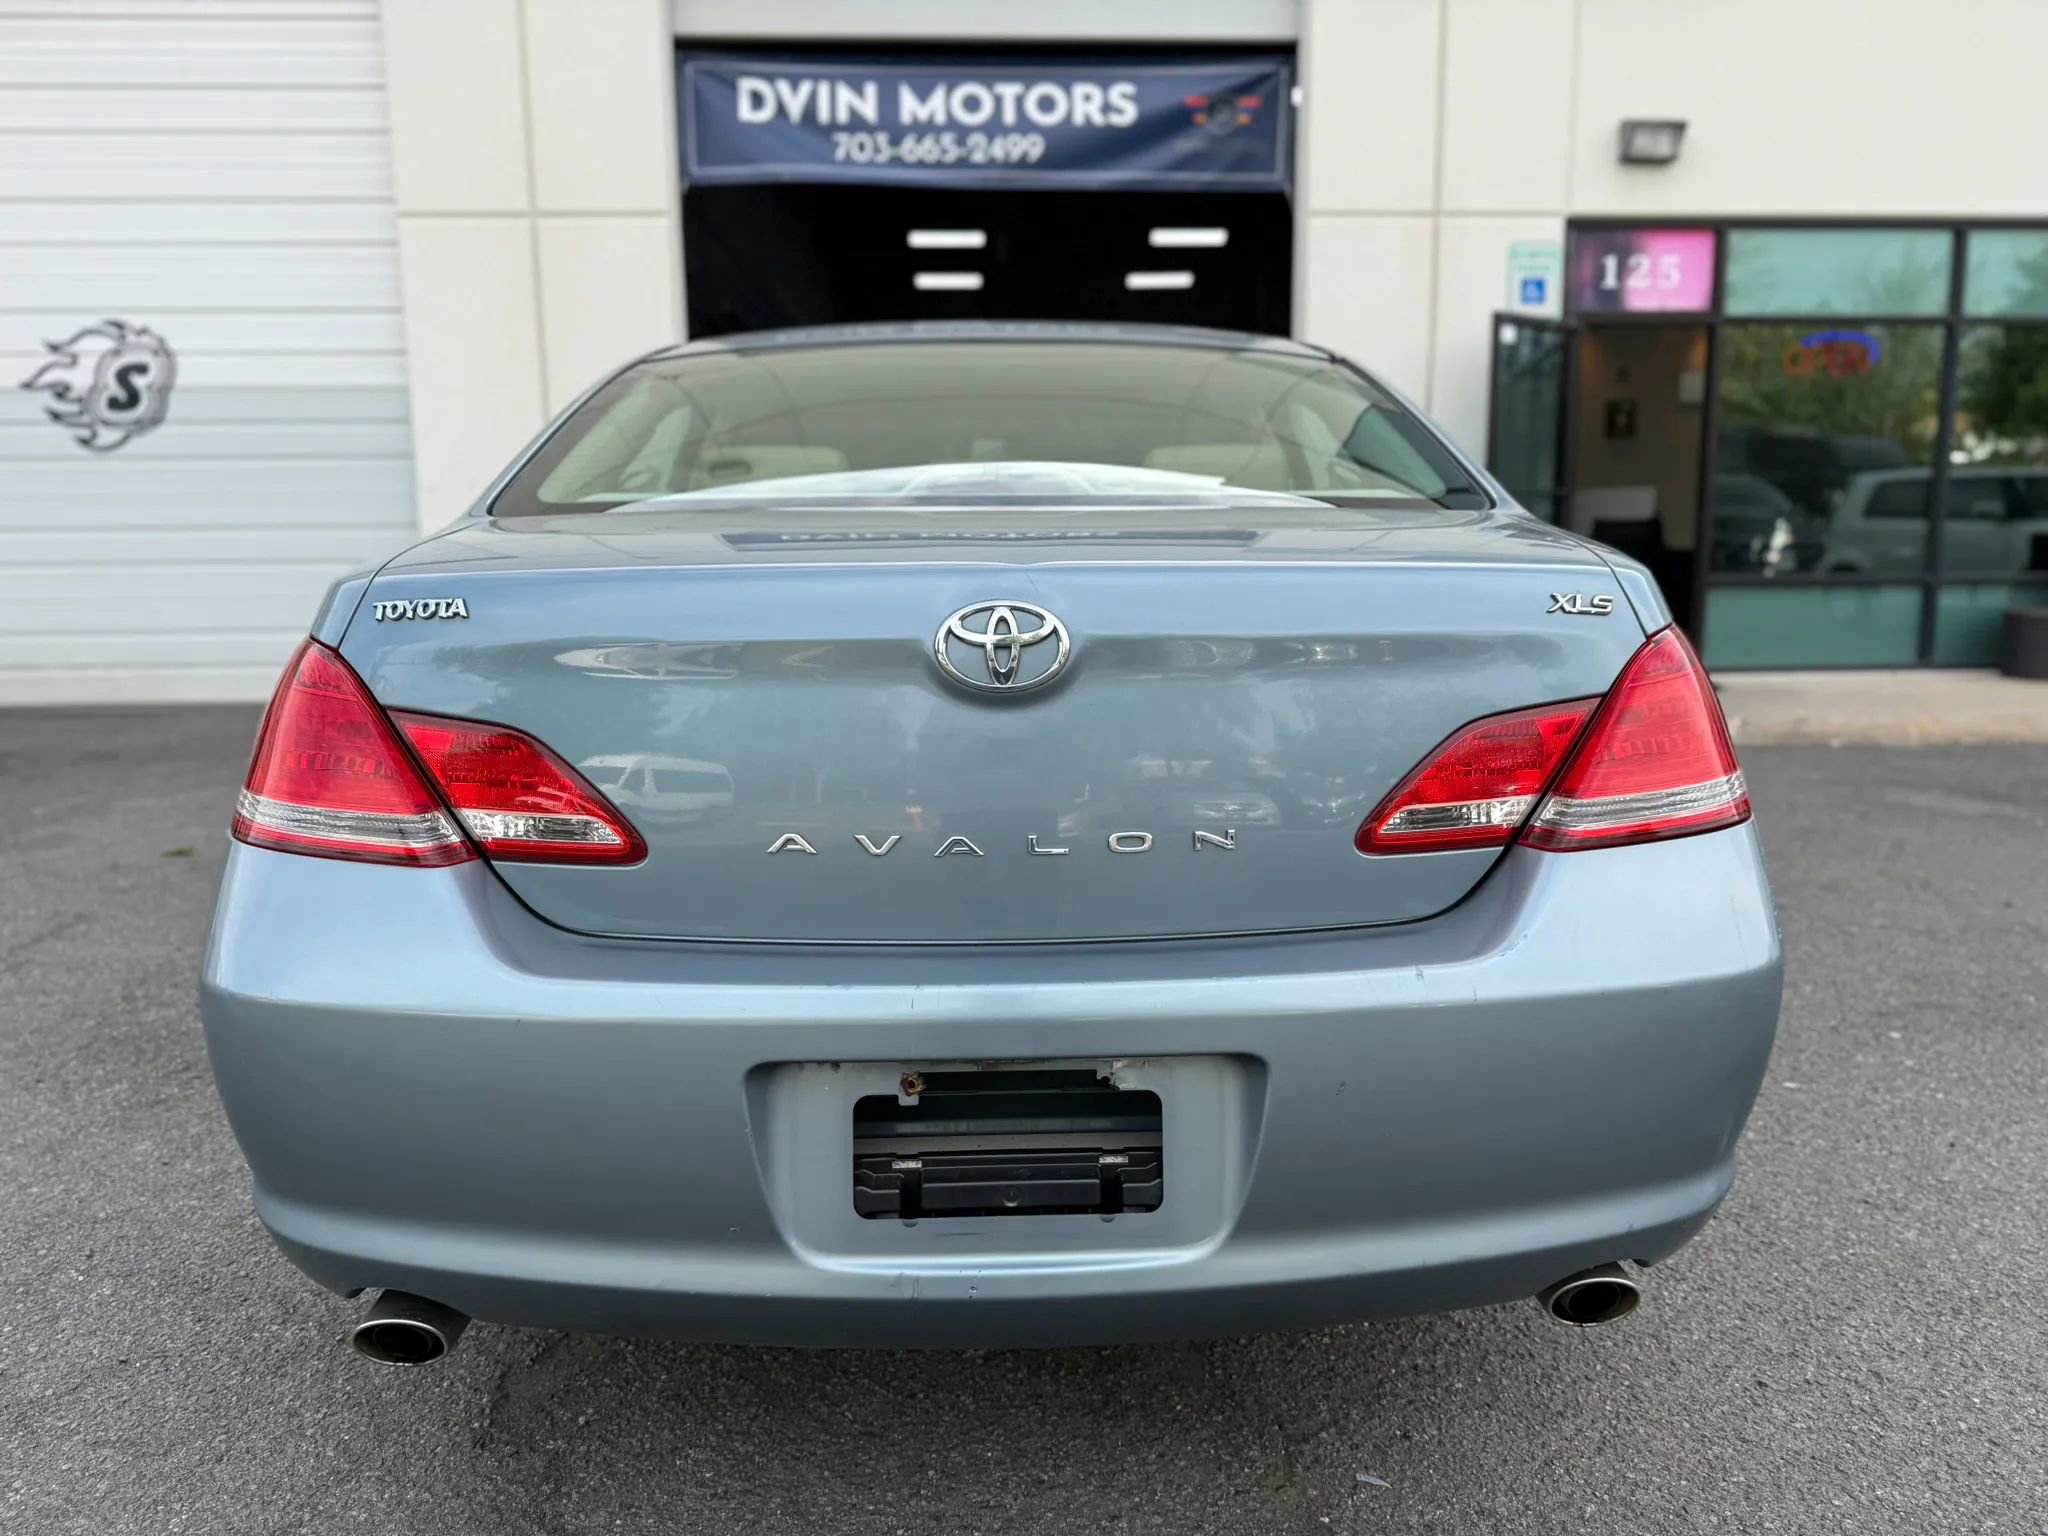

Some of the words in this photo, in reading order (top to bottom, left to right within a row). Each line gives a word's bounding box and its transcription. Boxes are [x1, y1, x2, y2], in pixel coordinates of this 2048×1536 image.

[736, 77, 879, 126] DVIN
[899, 81, 1139, 127] MOTORS
[832, 132, 1046, 165] 703-665-2499
[1599, 253, 1682, 290] 125
[106, 361, 150, 411] S
[373, 597, 469, 621] TOYOTA
[1546, 591, 1614, 616] XLS
[766, 827, 1236, 858] AVALON
